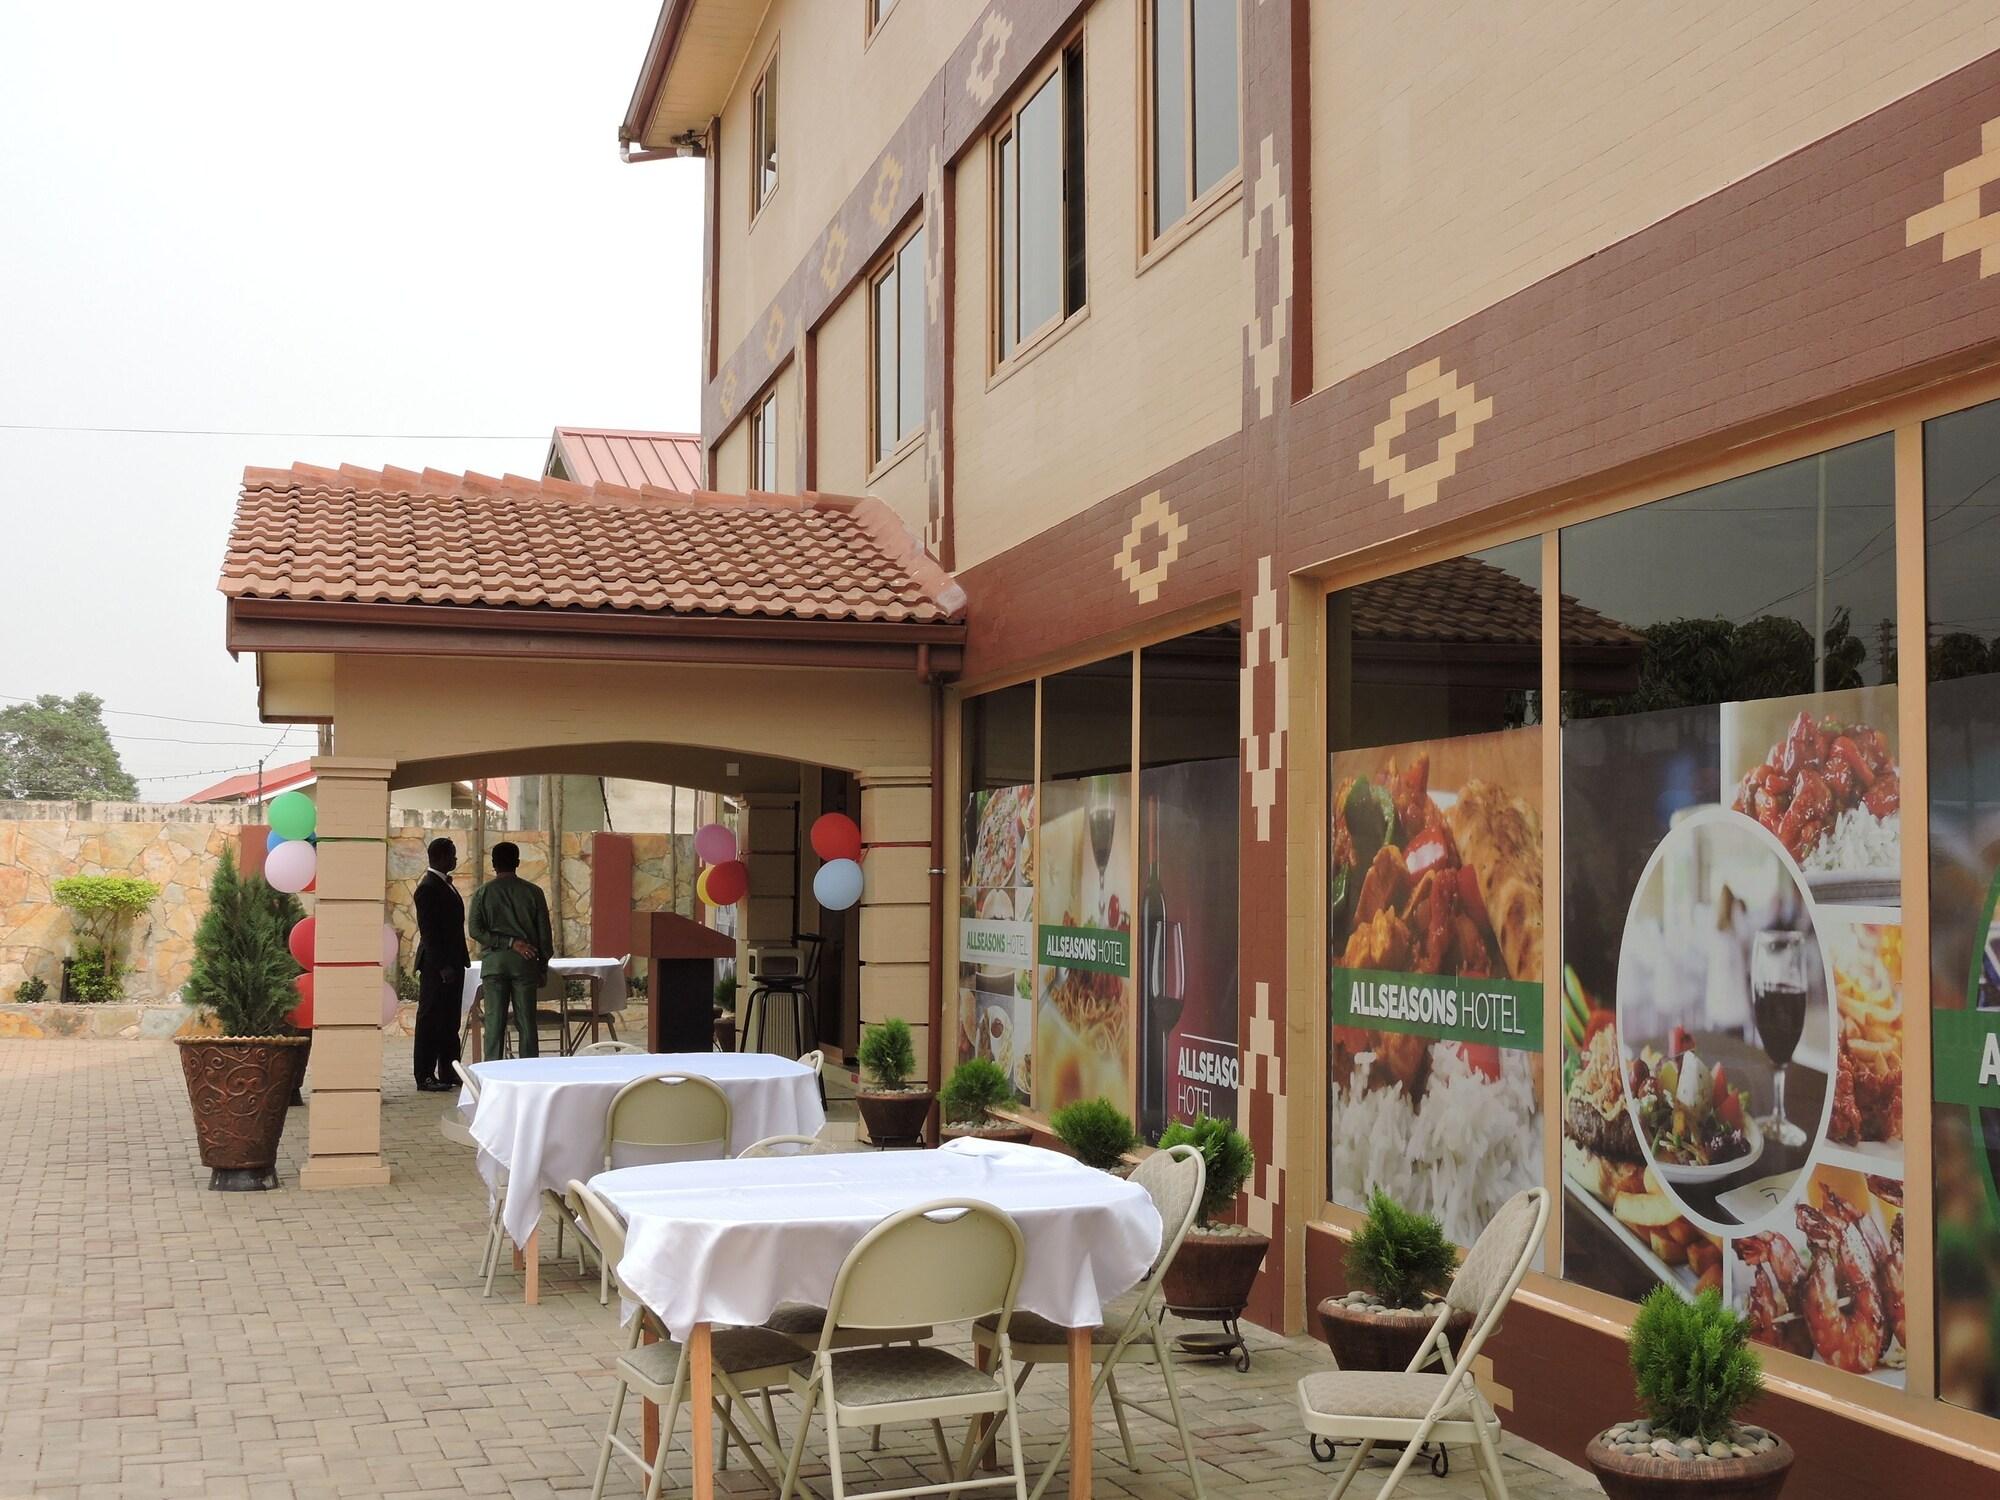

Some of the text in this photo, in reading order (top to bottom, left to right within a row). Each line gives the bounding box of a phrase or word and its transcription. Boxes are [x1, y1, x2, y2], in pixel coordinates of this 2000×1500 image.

[1046, 934, 1126, 966] ALLSEASONS HOTEL
[1350, 981, 1525, 1034] ALLSEASONS HOTEL
[1177, 1082, 1216, 1120] HOTEL
